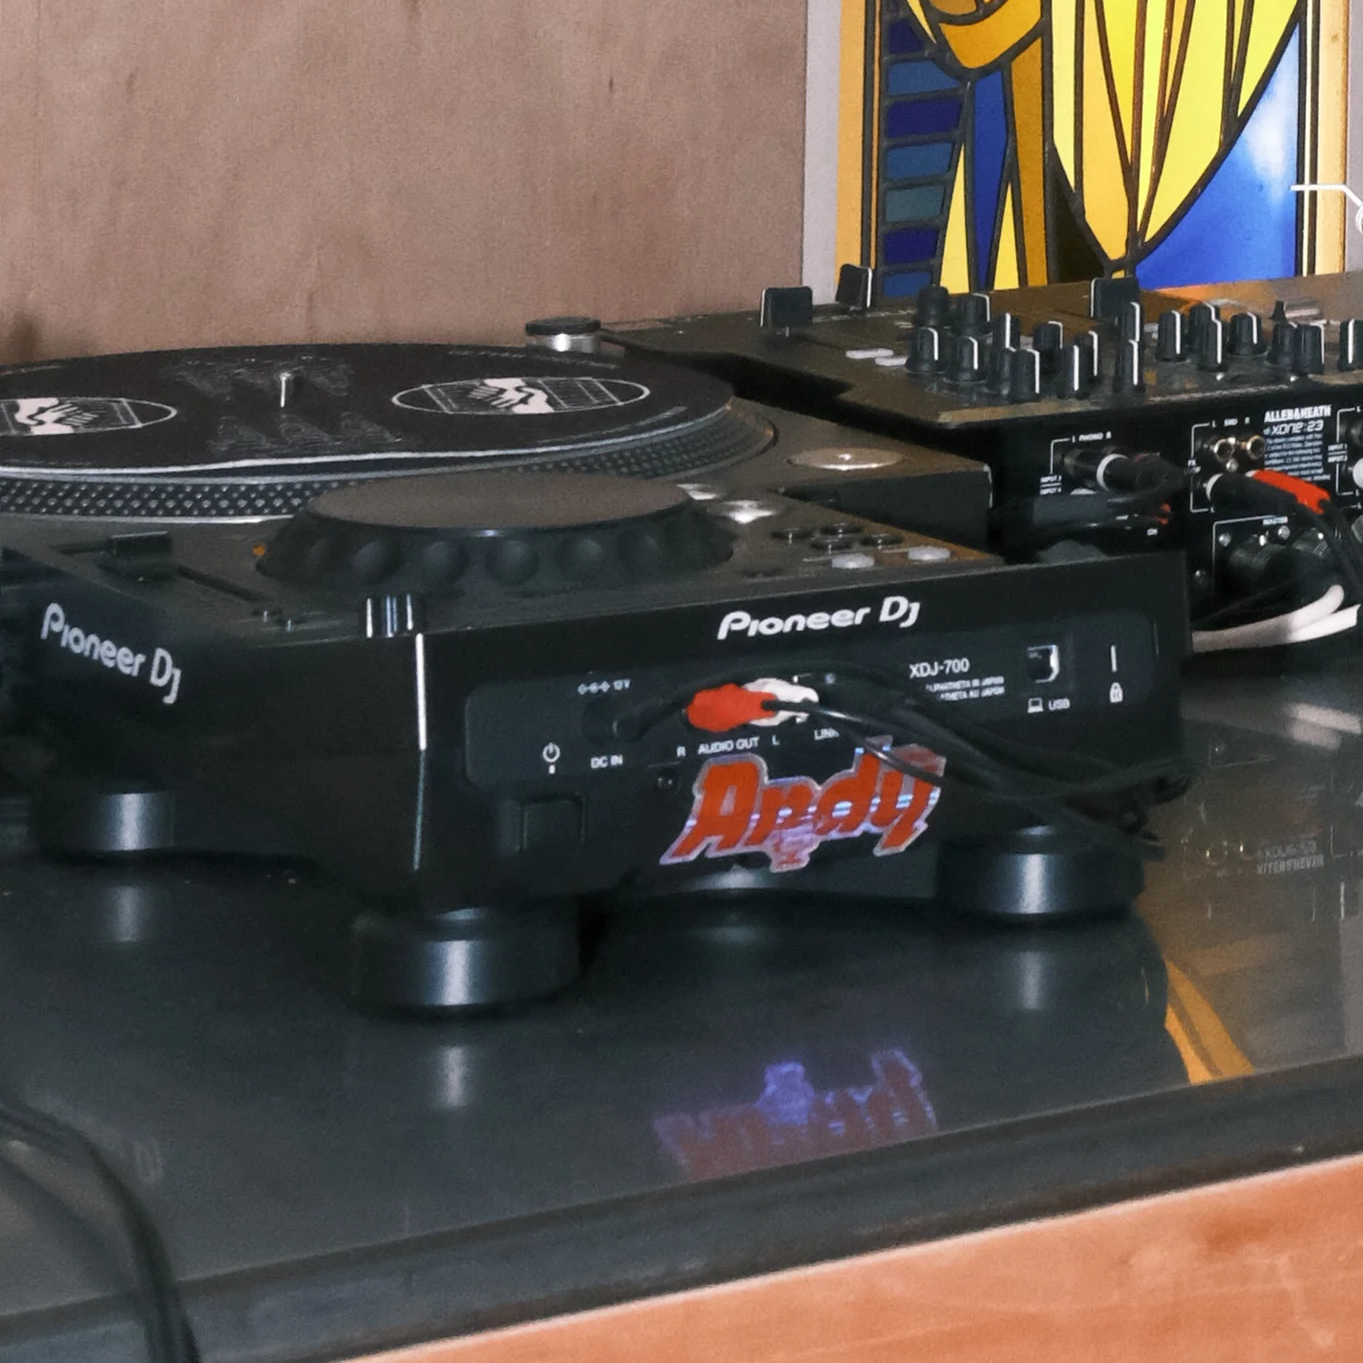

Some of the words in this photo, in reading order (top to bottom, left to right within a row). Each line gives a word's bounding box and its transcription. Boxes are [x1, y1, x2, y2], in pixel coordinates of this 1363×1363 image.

[1264, 405, 1332, 423] ALLEN&HEATH
[717, 604, 872, 641] Pioneer
[41, 602, 147, 679] Pioneer
[909, 657, 970, 680] XDJ-700
[1048, 697, 1070, 710] USB
[676, 746, 686, 757] R
[698, 740, 734, 754] AUDIO
[735, 736, 761, 751] OUT
[590, 757, 608, 768] DC
[610, 755, 624, 766] IN
[668, 748, 938, 858] Andy
